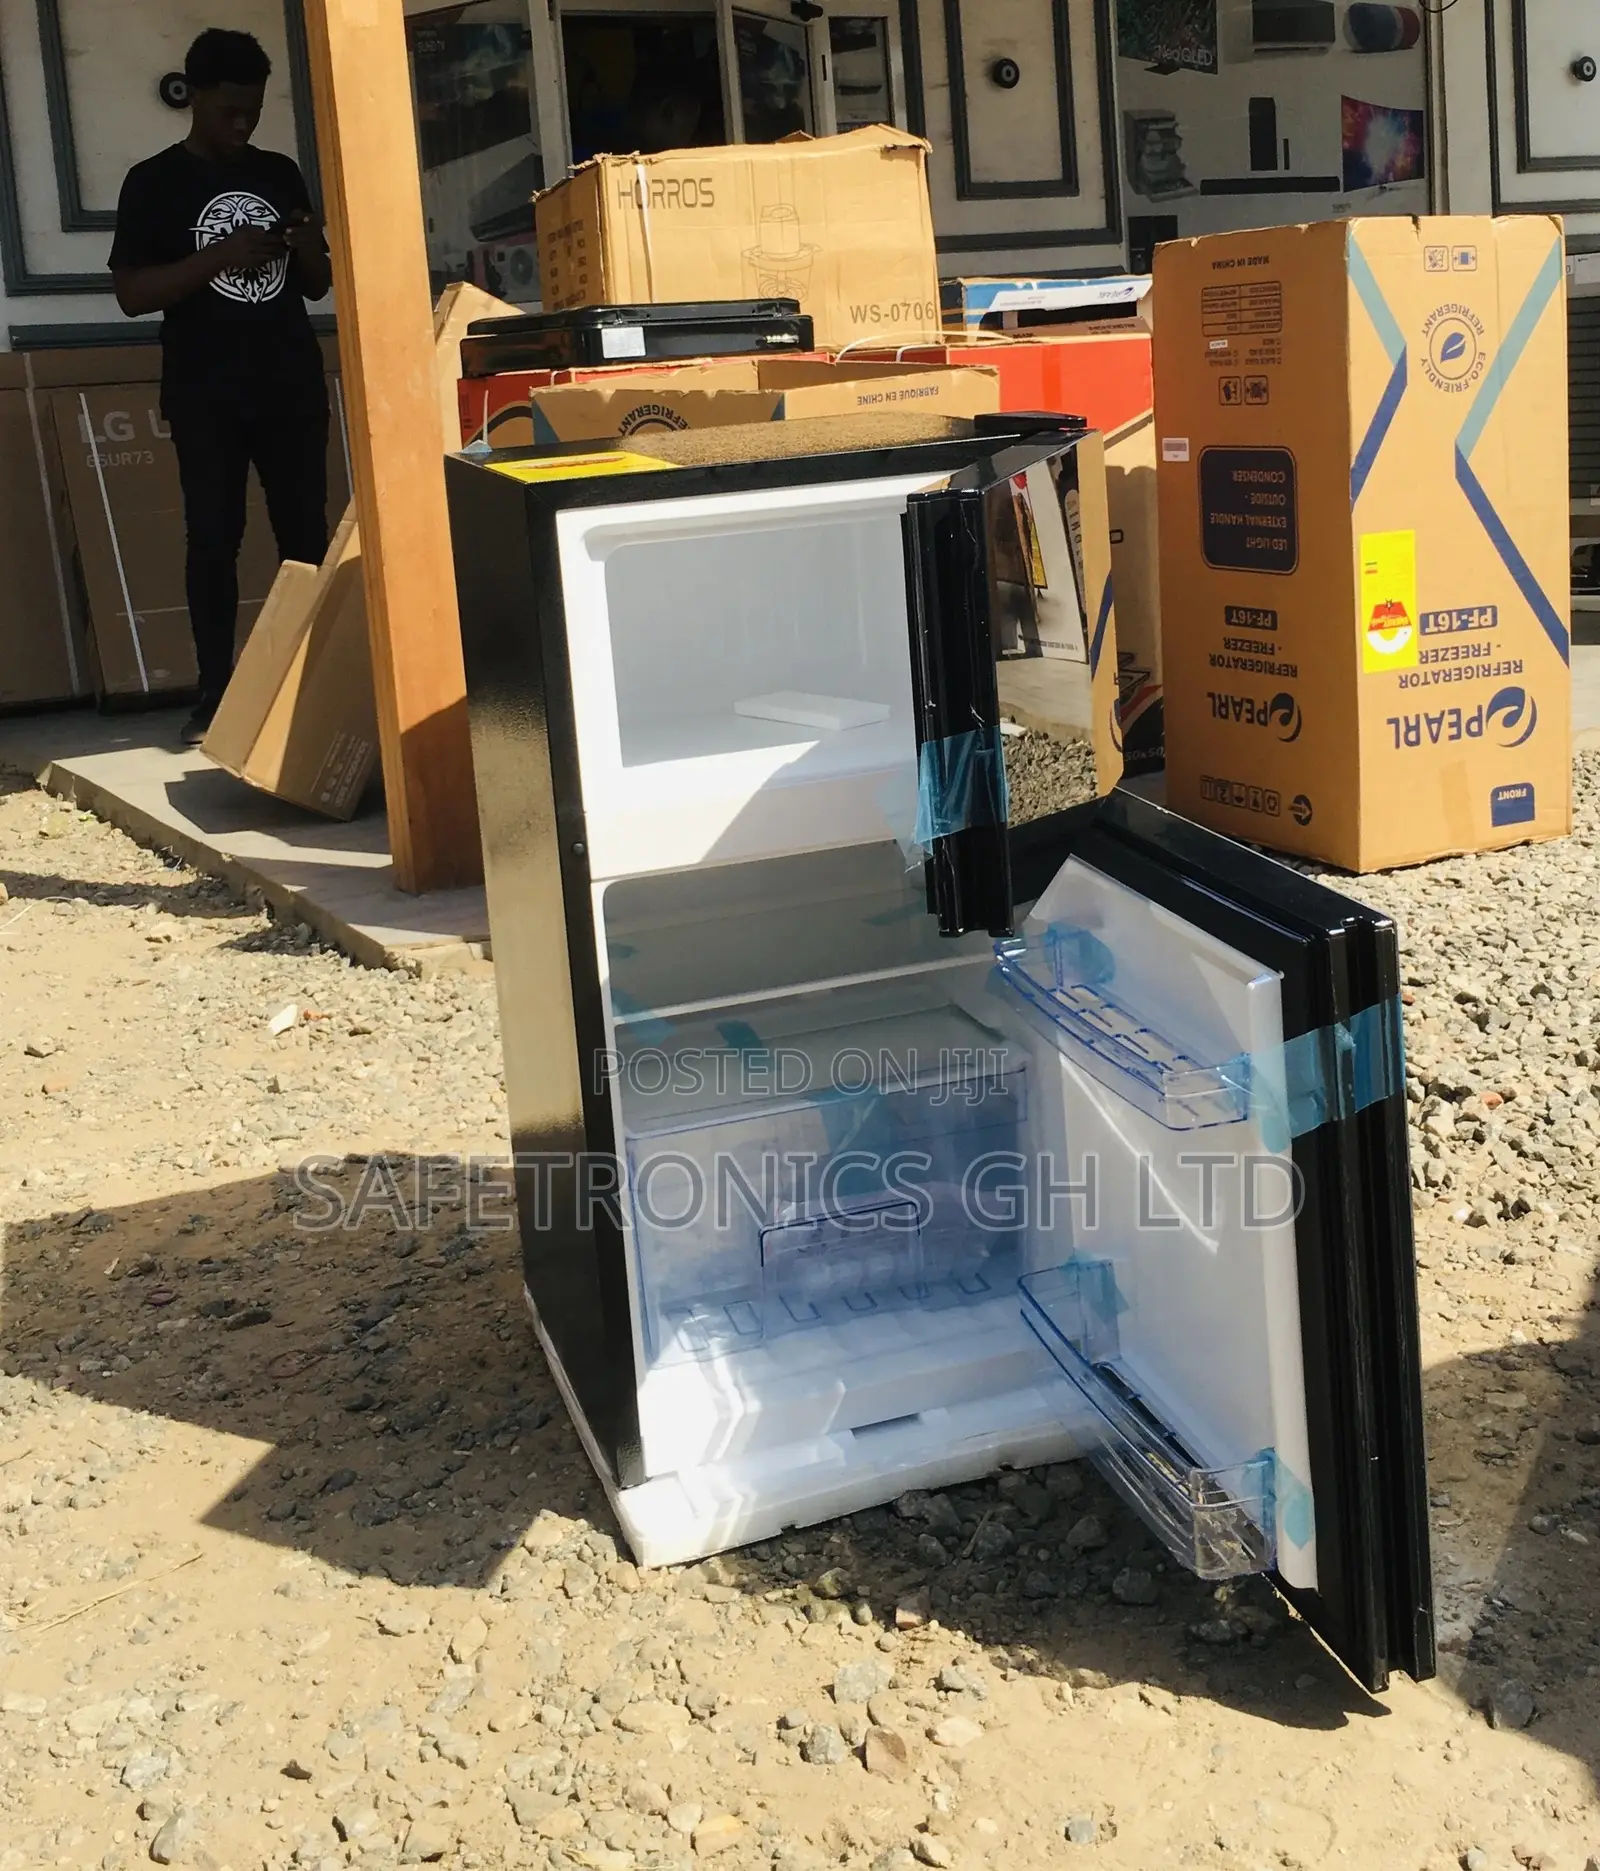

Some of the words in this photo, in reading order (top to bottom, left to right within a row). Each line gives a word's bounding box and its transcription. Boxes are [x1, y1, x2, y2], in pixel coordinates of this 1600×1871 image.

[1181, 46, 1213, 66] QLED
[616, 177, 716, 210] HORROS
[1211, 259, 1235, 270] CHINA
[1237, 258, 1246, 266] IN
[1247, 255, 1270, 266] MADE
[849, 301, 935, 324] WS-0706
[1421, 303, 1485, 338] REFRIGERANT
[1420, 351, 1487, 393] ECO-FRIENDLY
[856, 393, 884, 406] CHINE
[885, 391, 897, 402] EN
[77, 410, 136, 444] LG
[617, 404, 691, 437] EFRIGERANT
[1231, 470, 1286, 484] CONDENSER
[1250, 493, 1287, 505] OUTSIDE
[1209, 512, 1243, 526] HANDLE
[1244, 513, 1287, 528] EXTERNAL
[1246, 537, 1270, 550] LIGHT
[1272, 538, 1288, 551] LED
[1230, 608, 1273, 627] PF-16T
[1424, 608, 1493, 632] PF-16T
[1223, 636, 1276, 656] FREEZER
[1418, 641, 1491, 664] FREEZER
[1209, 652, 1298, 679] REFRIGERATOR
[1398, 658, 1524, 690] REFRIGERATOR
[1206, 691, 1269, 728] PEARL
[1386, 706, 1485, 750] PEARL
[1497, 786, 1528, 802] FRONT
